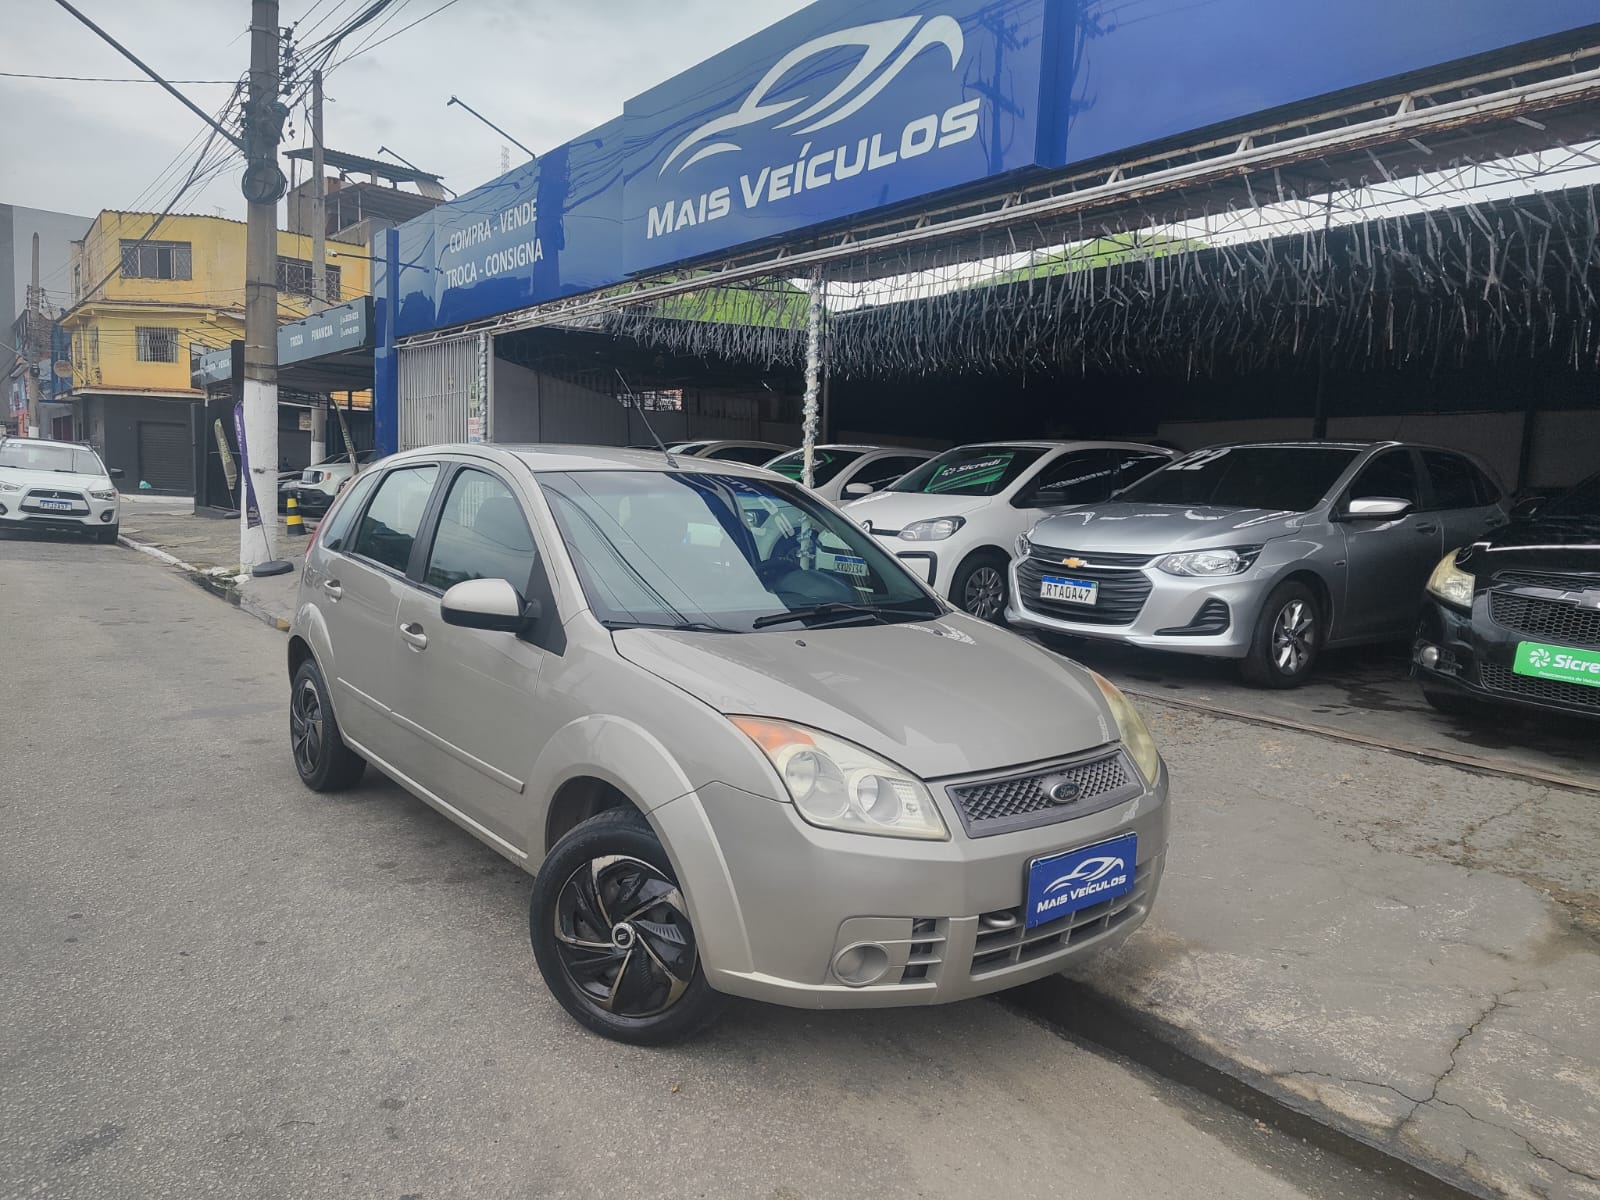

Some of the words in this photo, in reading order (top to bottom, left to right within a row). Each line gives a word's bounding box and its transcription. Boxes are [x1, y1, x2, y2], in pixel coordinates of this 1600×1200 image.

[647, 187, 731, 239] MAIS
[739, 98, 981, 209] VEÍCULOS
[449, 219, 491, 253] COMPRA
[500, 198, 538, 233] VENDE
[446, 261, 477, 289] TROCA
[485, 238, 543, 277] CONSIGNA
[956, 458, 1002, 473] Sicredi
[1166, 449, 1231, 470] 22
[1037, 894, 1068, 913] MAIS
[1070, 874, 1127, 899] VEÍCULOS
